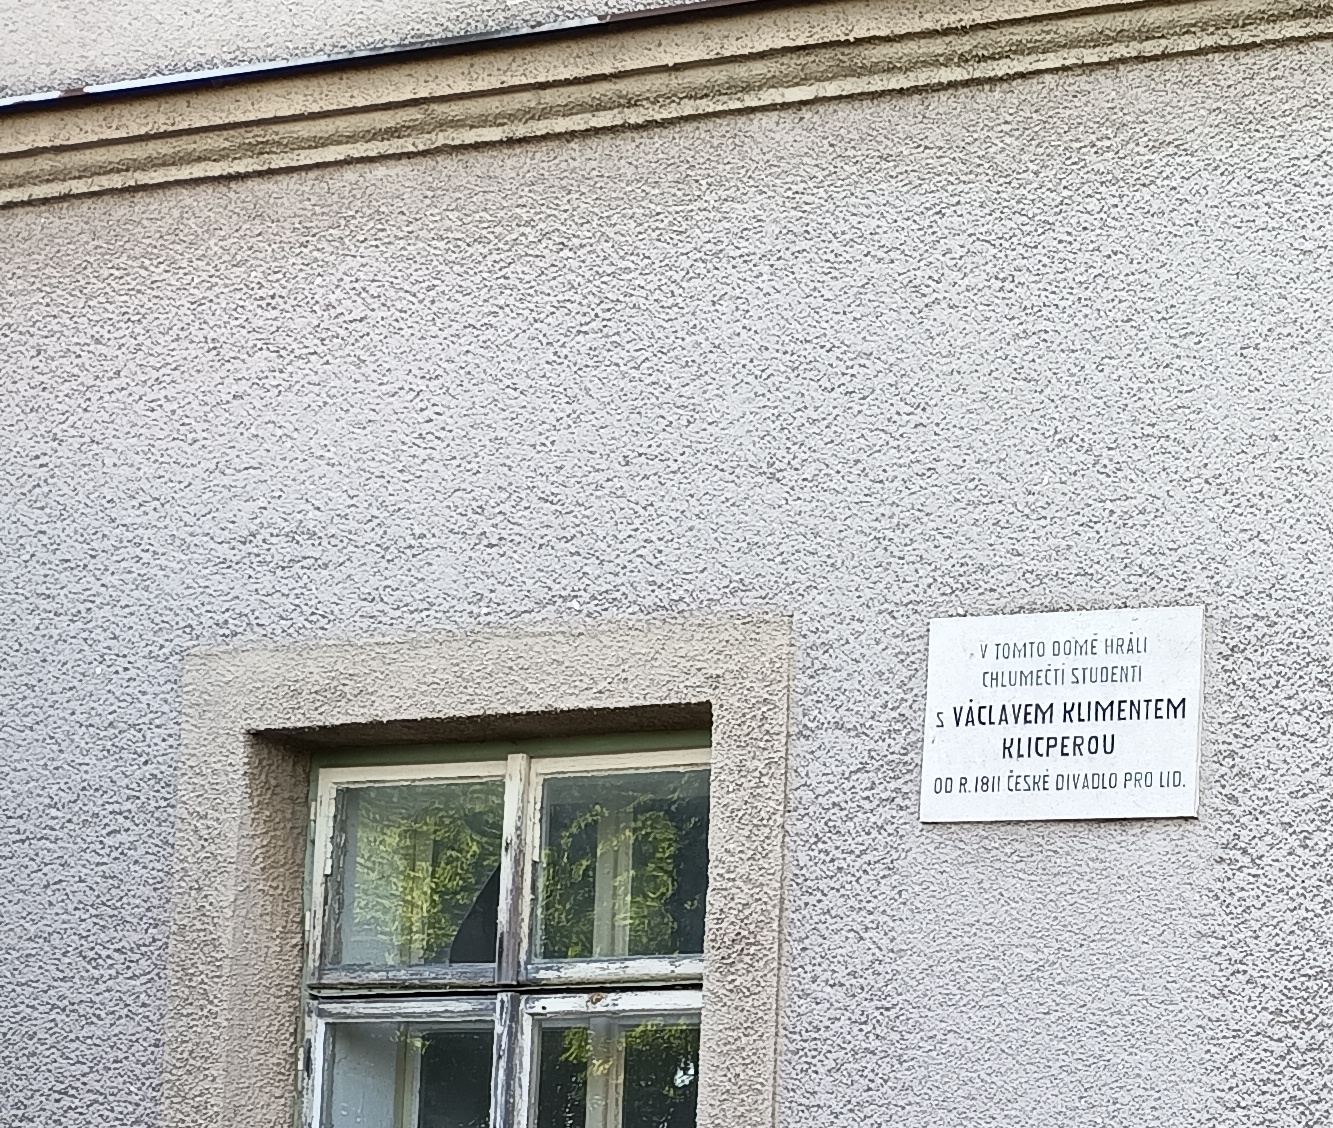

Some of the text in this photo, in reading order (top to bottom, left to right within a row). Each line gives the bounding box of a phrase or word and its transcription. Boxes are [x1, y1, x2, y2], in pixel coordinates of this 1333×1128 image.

[980, 632, 1148, 660] V TOMTO DOMĚ HRÁLI
[982, 663, 1143, 688] CHLUMEČTÍ STUDENTI
[953, 698, 1054, 728] VÁCLAVEM
[1062, 697, 1187, 724] KLIMENTEM
[1002, 734, 1116, 760] KLICPEROU
[933, 776, 953, 794] OD
[1007, 769, 1050, 792] ČESKÉ
[1056, 772, 1117, 791] DIVADLO
[1124, 771, 1152, 789] PRO
[1160, 771, 1186, 788] LID.
